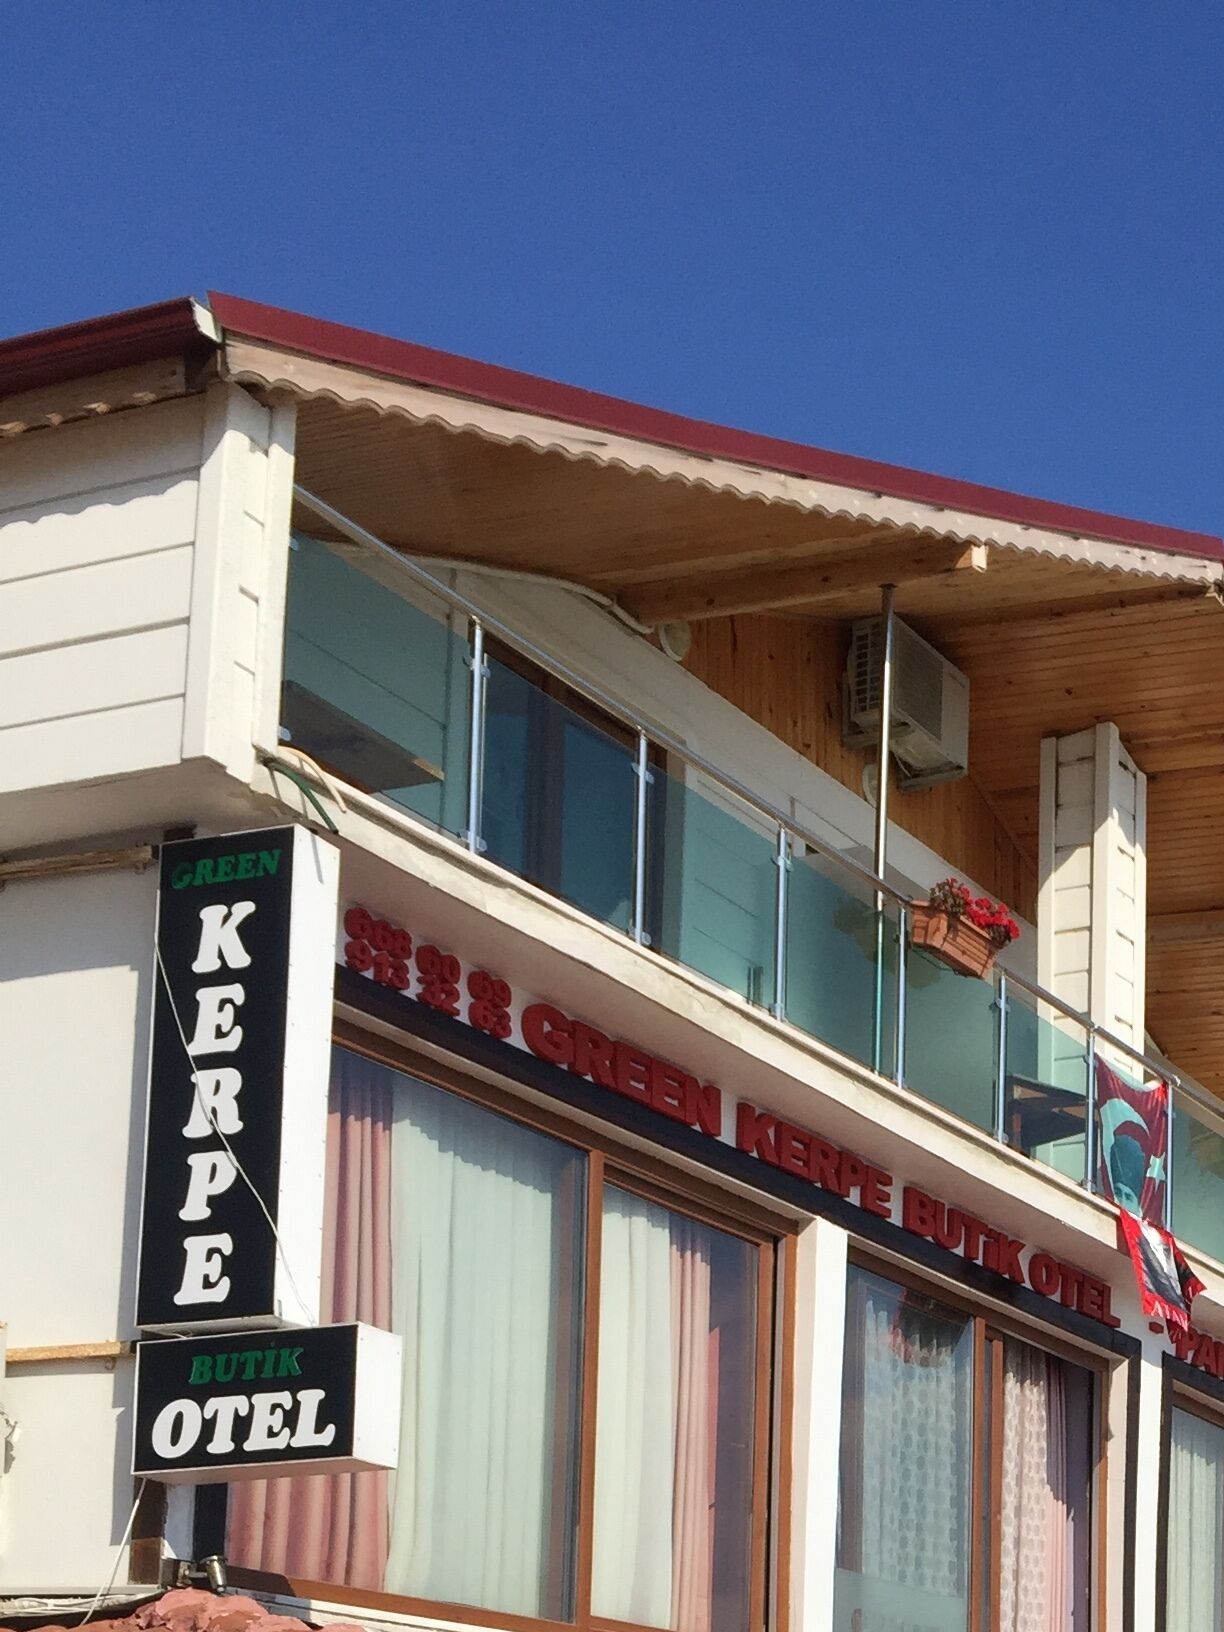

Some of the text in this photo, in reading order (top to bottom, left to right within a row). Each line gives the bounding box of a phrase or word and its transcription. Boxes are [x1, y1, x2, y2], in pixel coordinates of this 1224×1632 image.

[172, 848, 281, 890] GREEN
[173, 900, 256, 1306] KERPE
[521, 1003, 721, 1137] GREEN
[736, 1102, 892, 1219] KERPE
[1028, 1253, 1121, 1328] OTEL
[151, 1388, 335, 1459] OTEL
